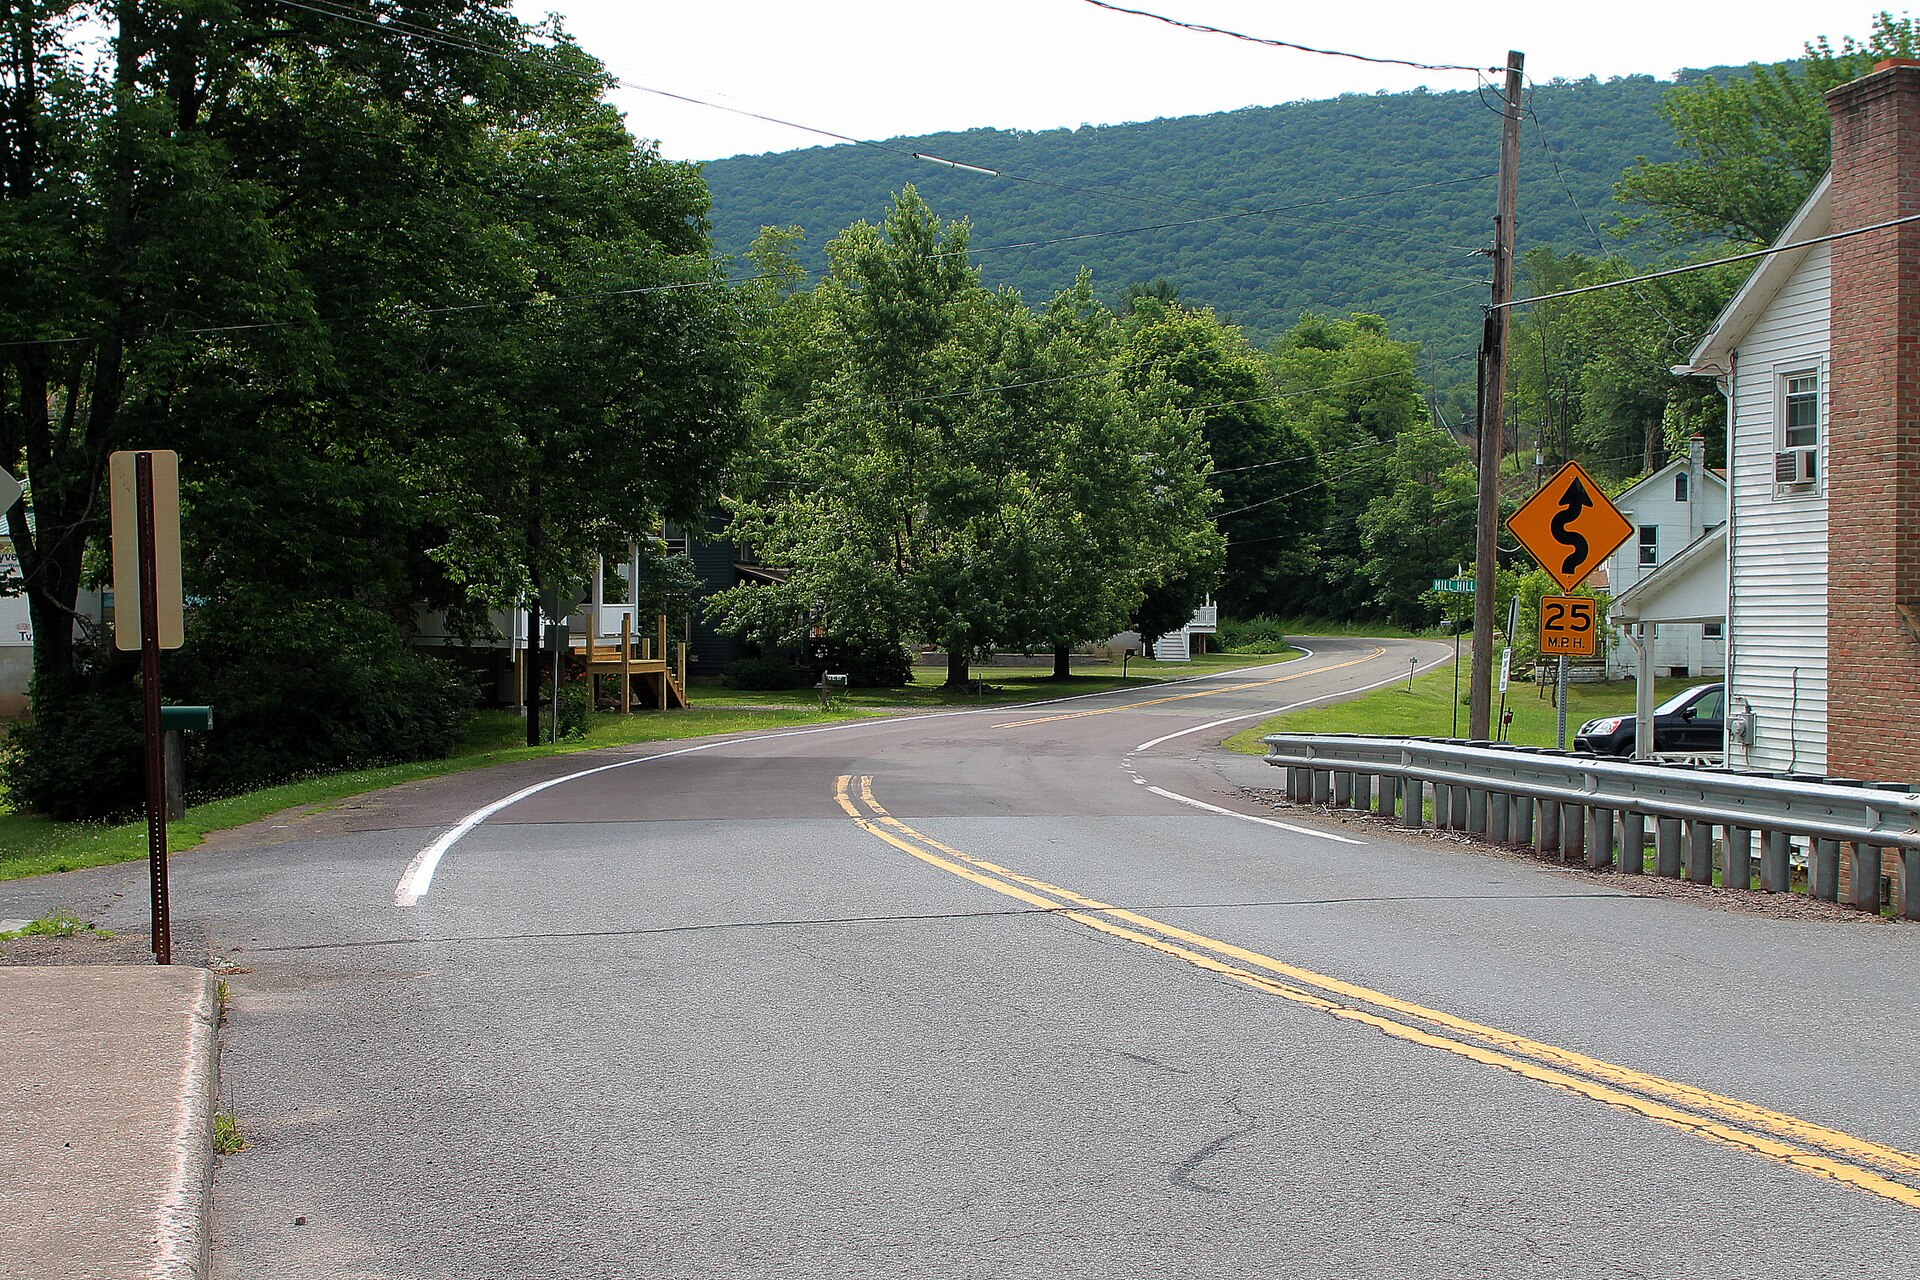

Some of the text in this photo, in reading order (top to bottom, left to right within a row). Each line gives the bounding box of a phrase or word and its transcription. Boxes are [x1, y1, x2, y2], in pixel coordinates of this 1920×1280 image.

[1434, 579, 1475, 592] MILL HILL
[1544, 603, 1591, 632] 25
